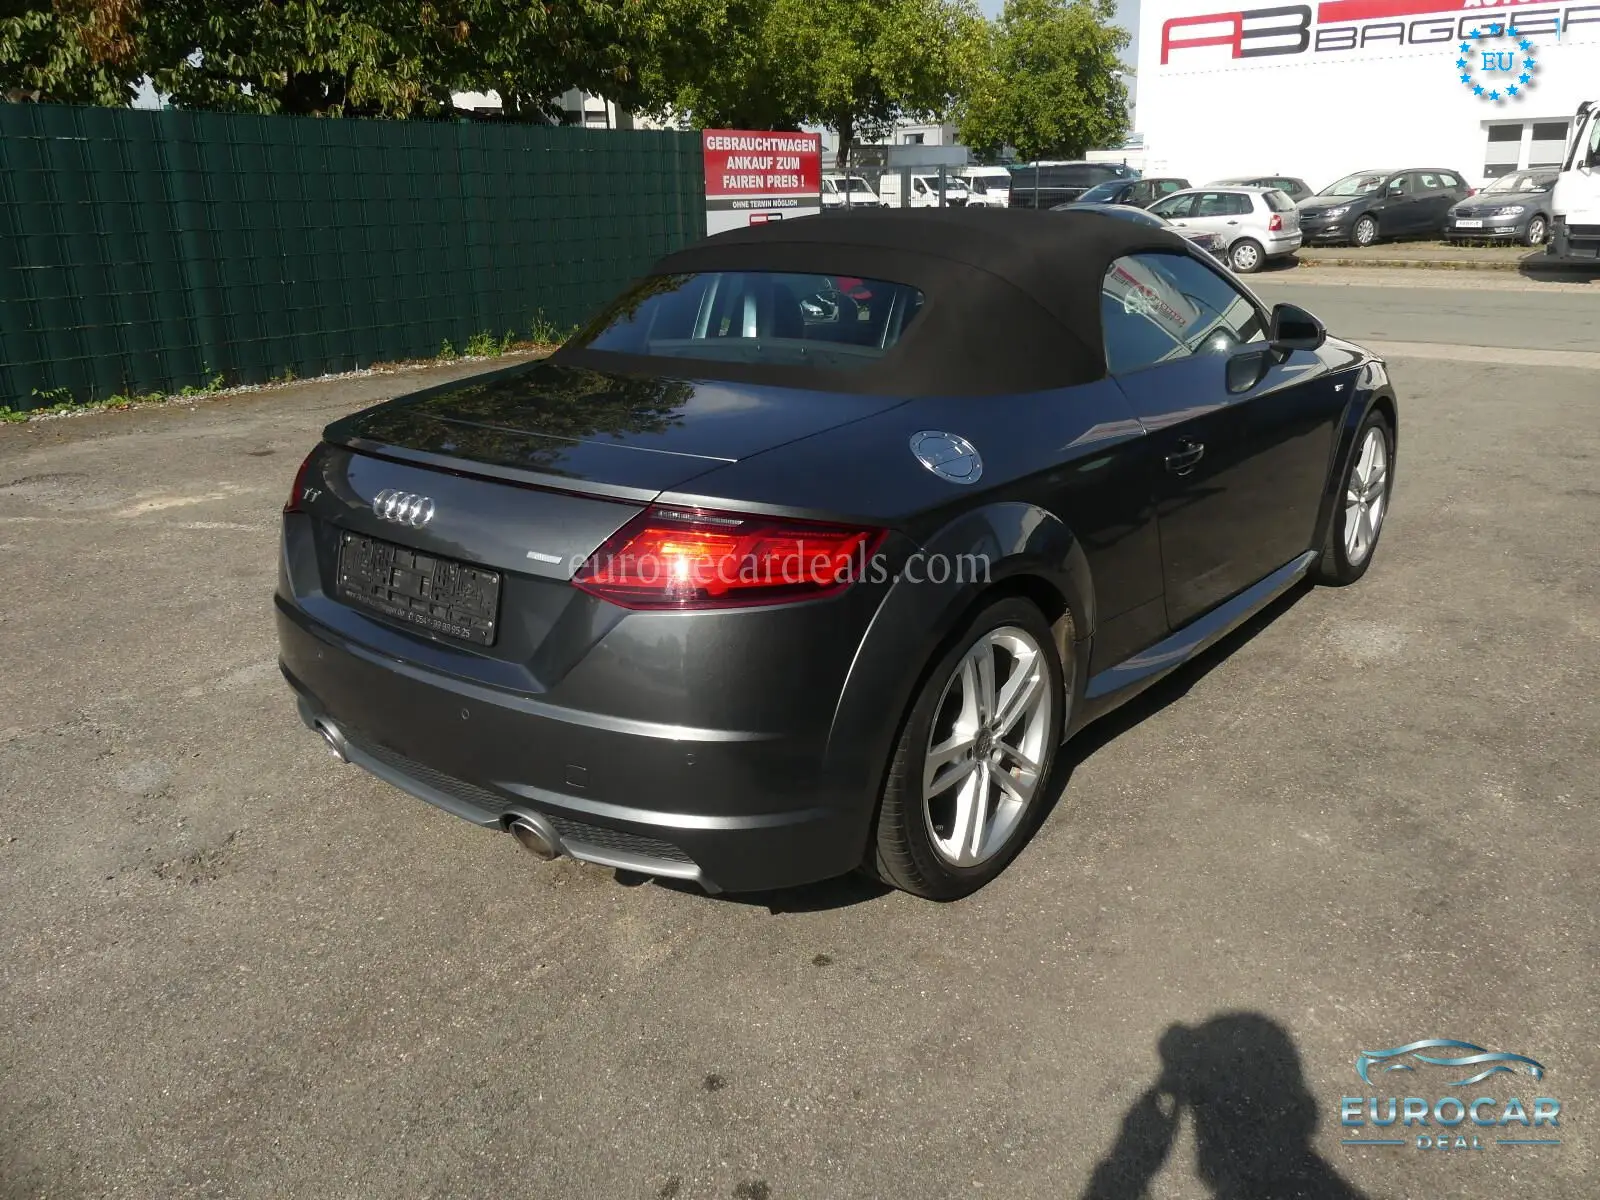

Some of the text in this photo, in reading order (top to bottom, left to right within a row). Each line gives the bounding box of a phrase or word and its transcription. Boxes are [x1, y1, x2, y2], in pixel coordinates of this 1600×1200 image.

[706, 135, 816, 152] GEBRAUCHTWAGEN
[726, 156, 800, 170] ANKAUF ZUM
[722, 174, 764, 189] FAIREN
[766, 174, 799, 188] PREIS
[732, 198, 798, 209] OHNE TERMIN MÖGLICH
[303, 487, 323, 503] TT
